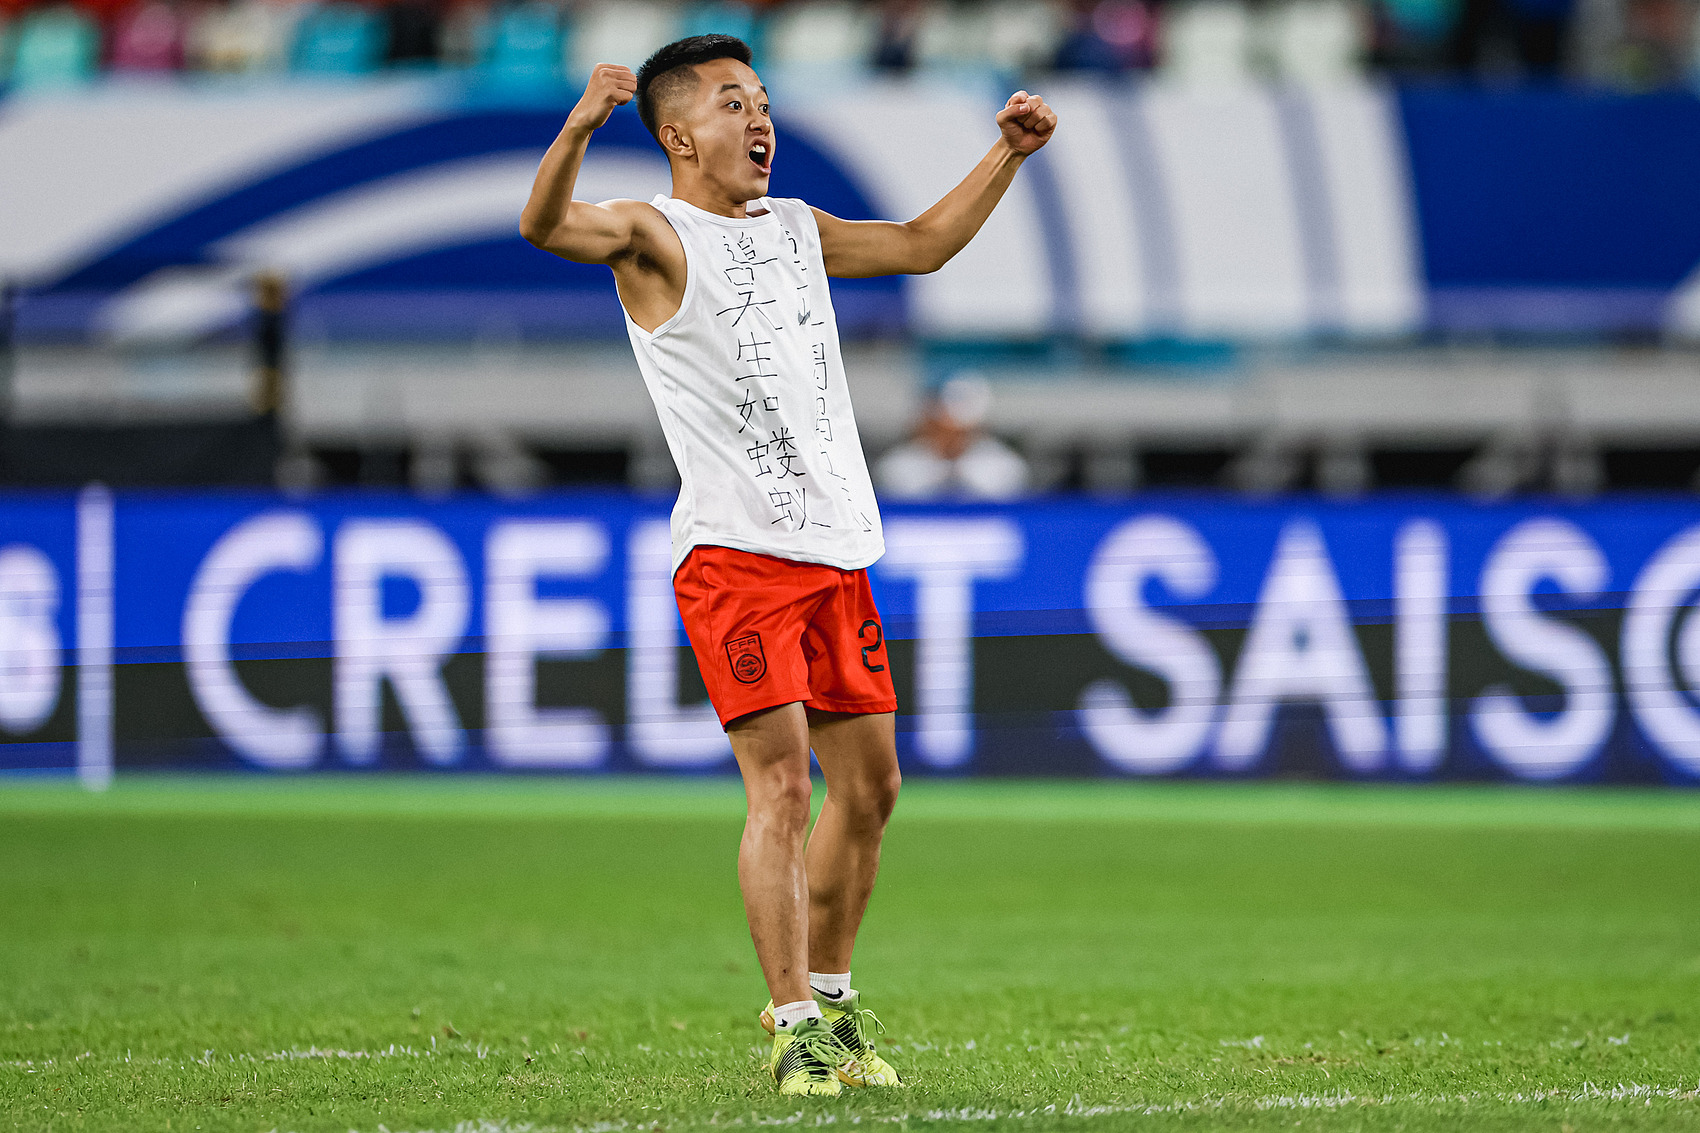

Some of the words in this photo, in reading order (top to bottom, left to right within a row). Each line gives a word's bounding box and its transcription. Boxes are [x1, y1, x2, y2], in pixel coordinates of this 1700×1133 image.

[183, 511, 1025, 769] CRET
[729, 637, 757, 652] CFA
[858, 619, 885, 673] 2
